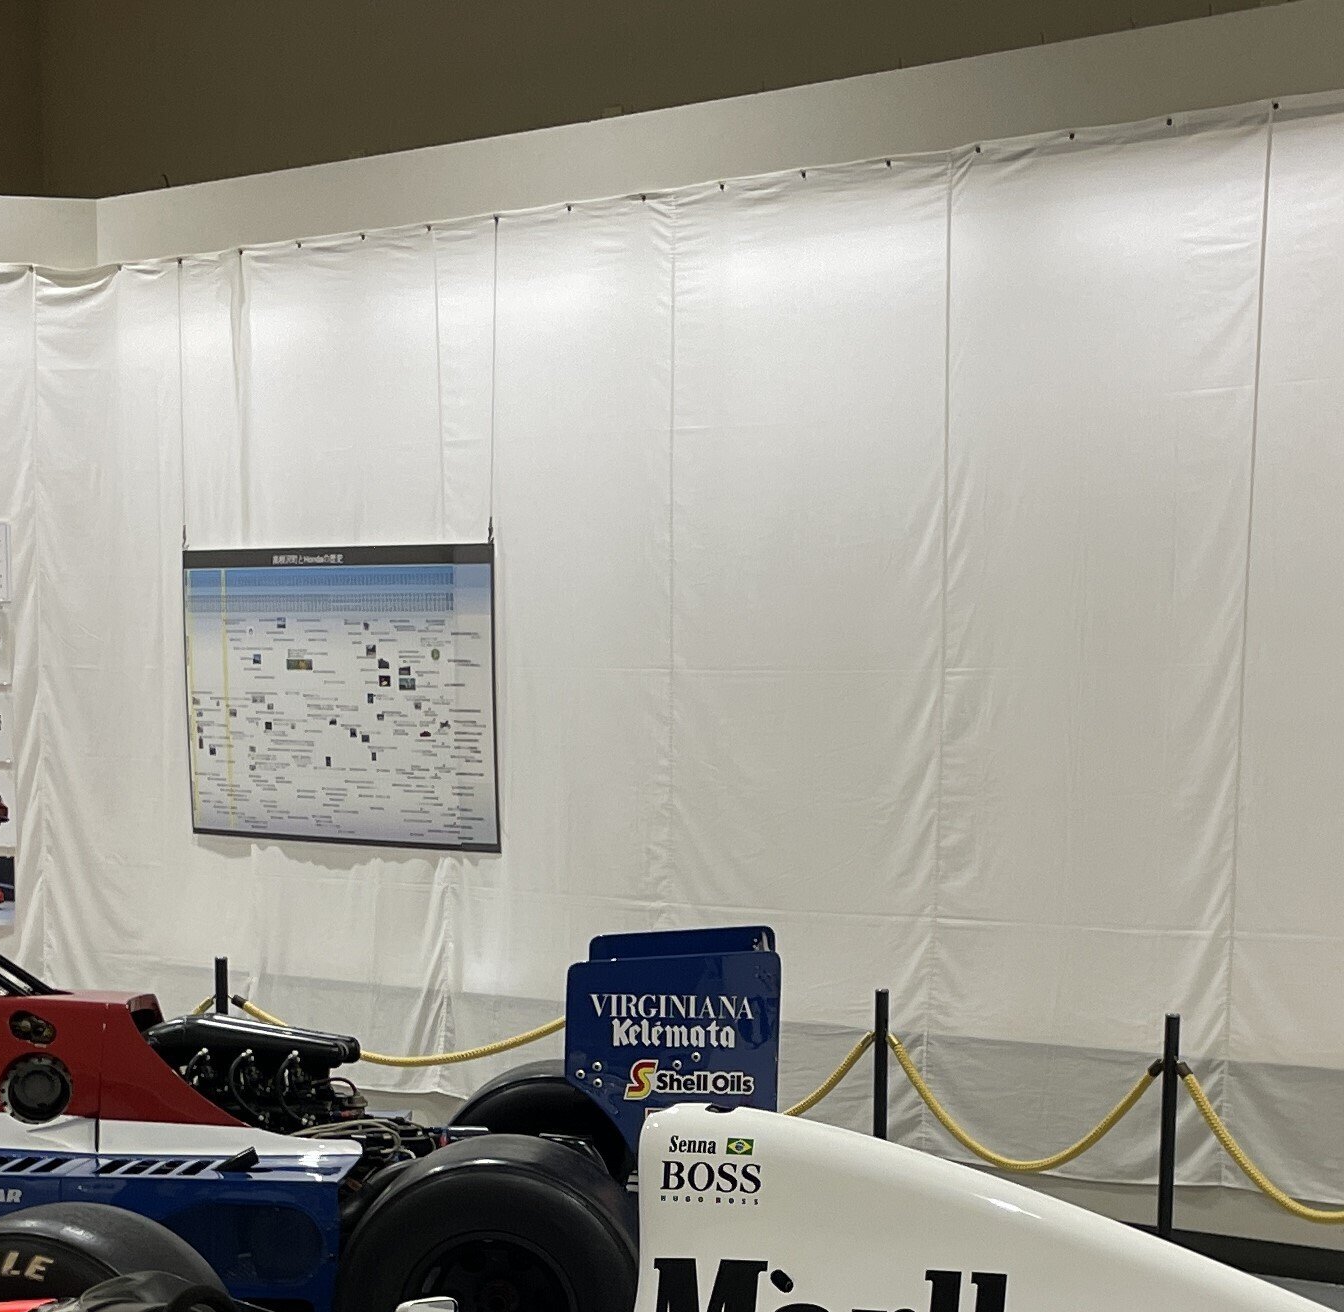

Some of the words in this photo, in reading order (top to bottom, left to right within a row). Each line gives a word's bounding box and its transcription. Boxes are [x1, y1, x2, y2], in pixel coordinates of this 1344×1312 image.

[589, 993, 754, 1020] VIRGINIANA
[656, 1072, 710, 1093] Shell
[712, 1073, 754, 1093] Oils
[669, 1135, 716, 1154] Senna
[660, 1160, 761, 1194] BOSS
[661, 1195, 704, 1203] HUGO
